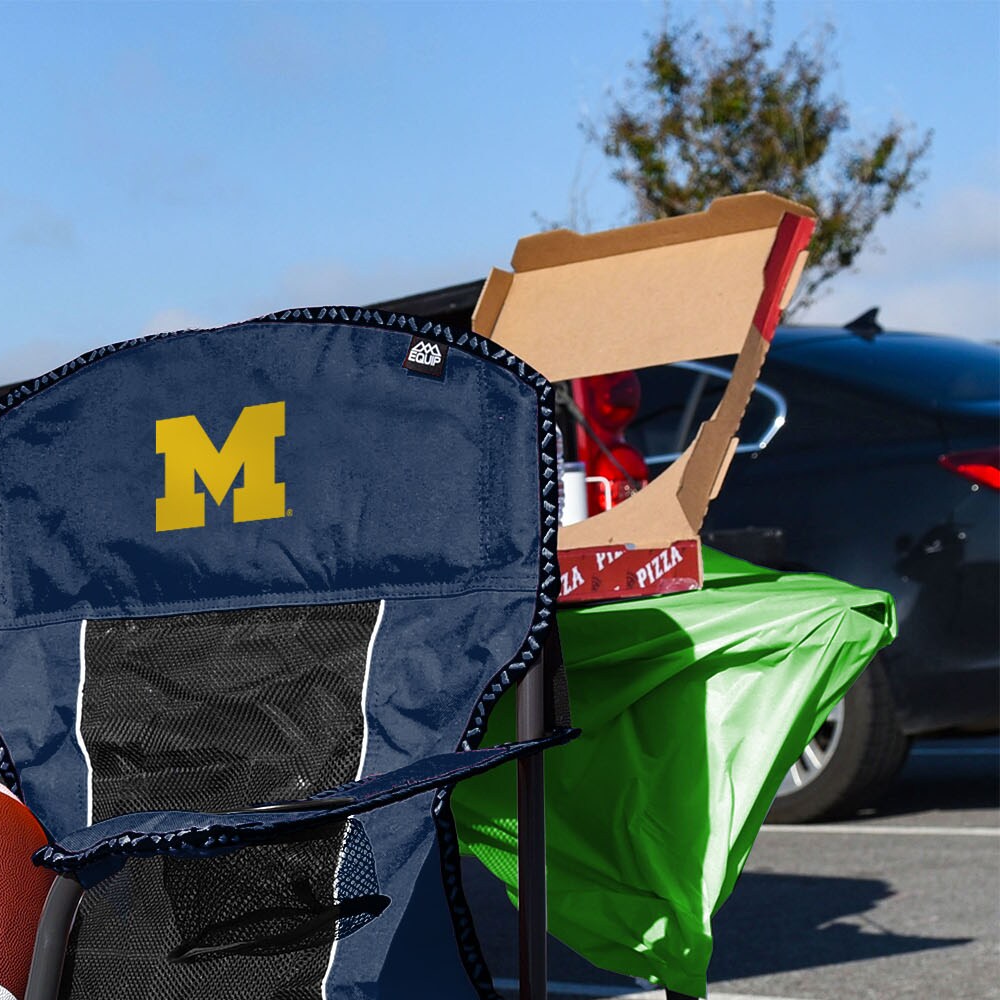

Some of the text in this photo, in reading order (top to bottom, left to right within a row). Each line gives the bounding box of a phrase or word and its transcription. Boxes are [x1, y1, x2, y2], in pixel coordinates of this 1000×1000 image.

[408, 350, 441, 366] EQUIP
[156, 401, 285, 532] M
[636, 546, 683, 588] PIZZA
